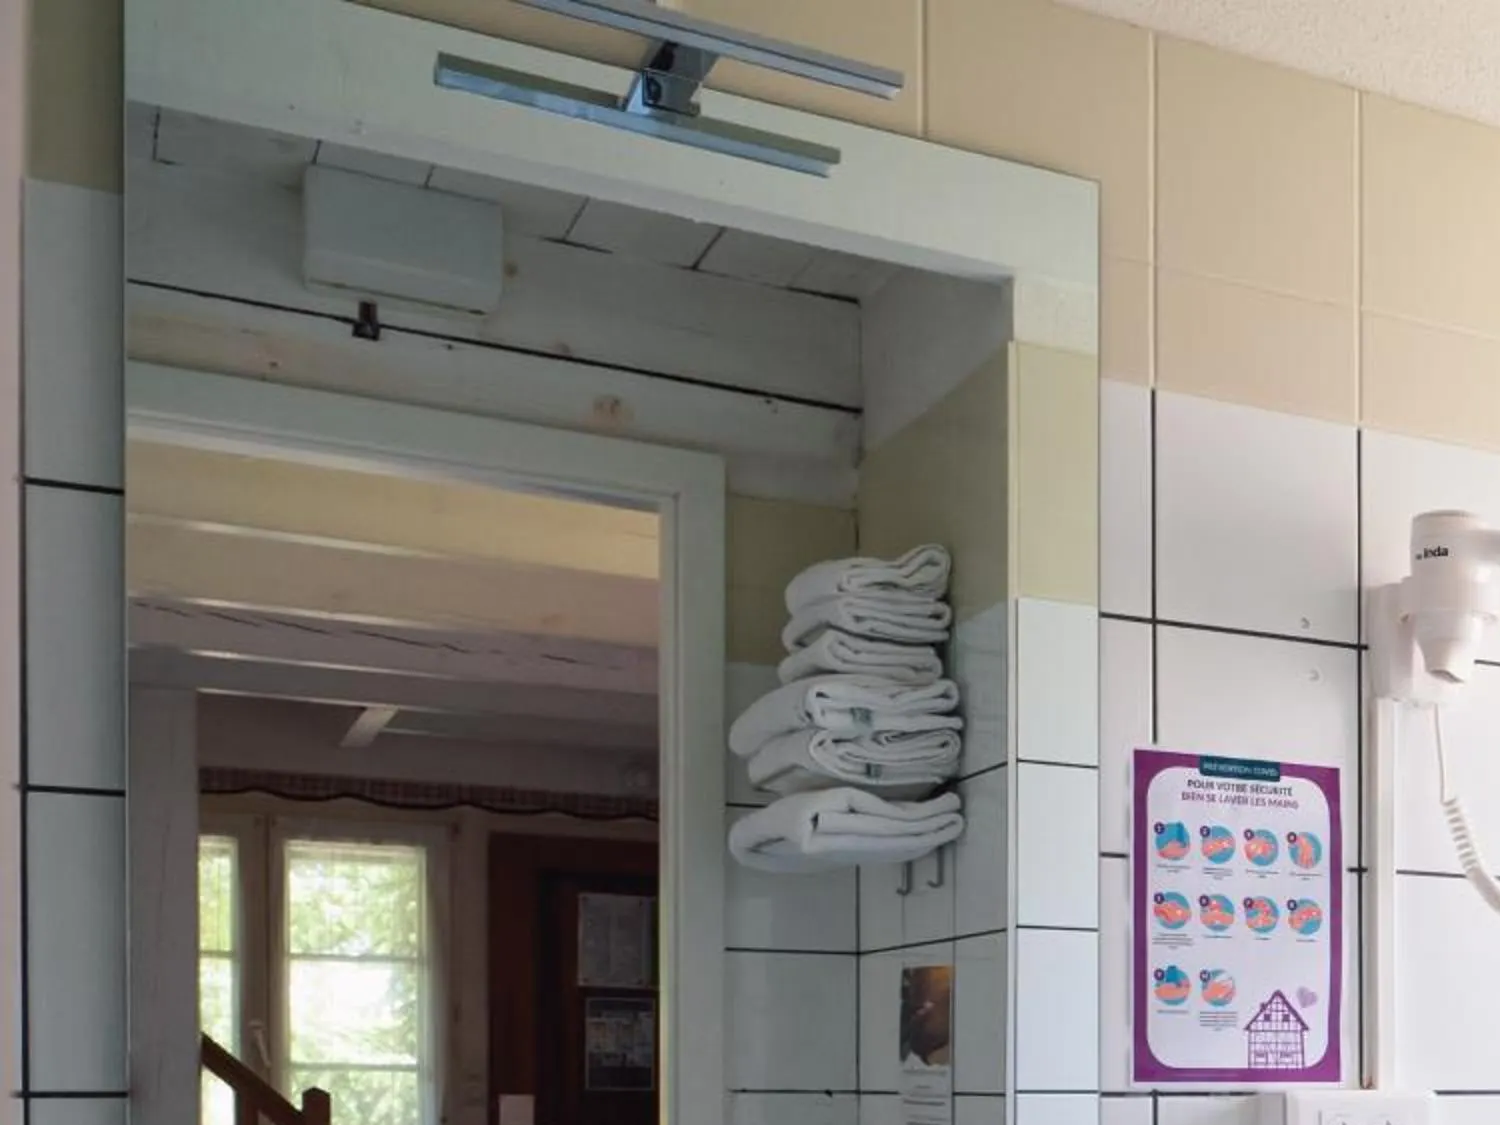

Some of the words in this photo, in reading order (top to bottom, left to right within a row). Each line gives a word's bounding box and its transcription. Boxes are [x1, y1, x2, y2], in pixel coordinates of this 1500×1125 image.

[1187, 779, 1215, 790] POUR
[1217, 782, 1247, 793] VOTRE
[1250, 783, 1292, 796] SÉCURITÉ
[1181, 791, 1204, 801] BIEN
[1206, 793, 1216, 803] SE
[1219, 794, 1248, 805] LAVER
[1251, 796, 1266, 807] LES
[1267, 799, 1299, 810] MAINS
